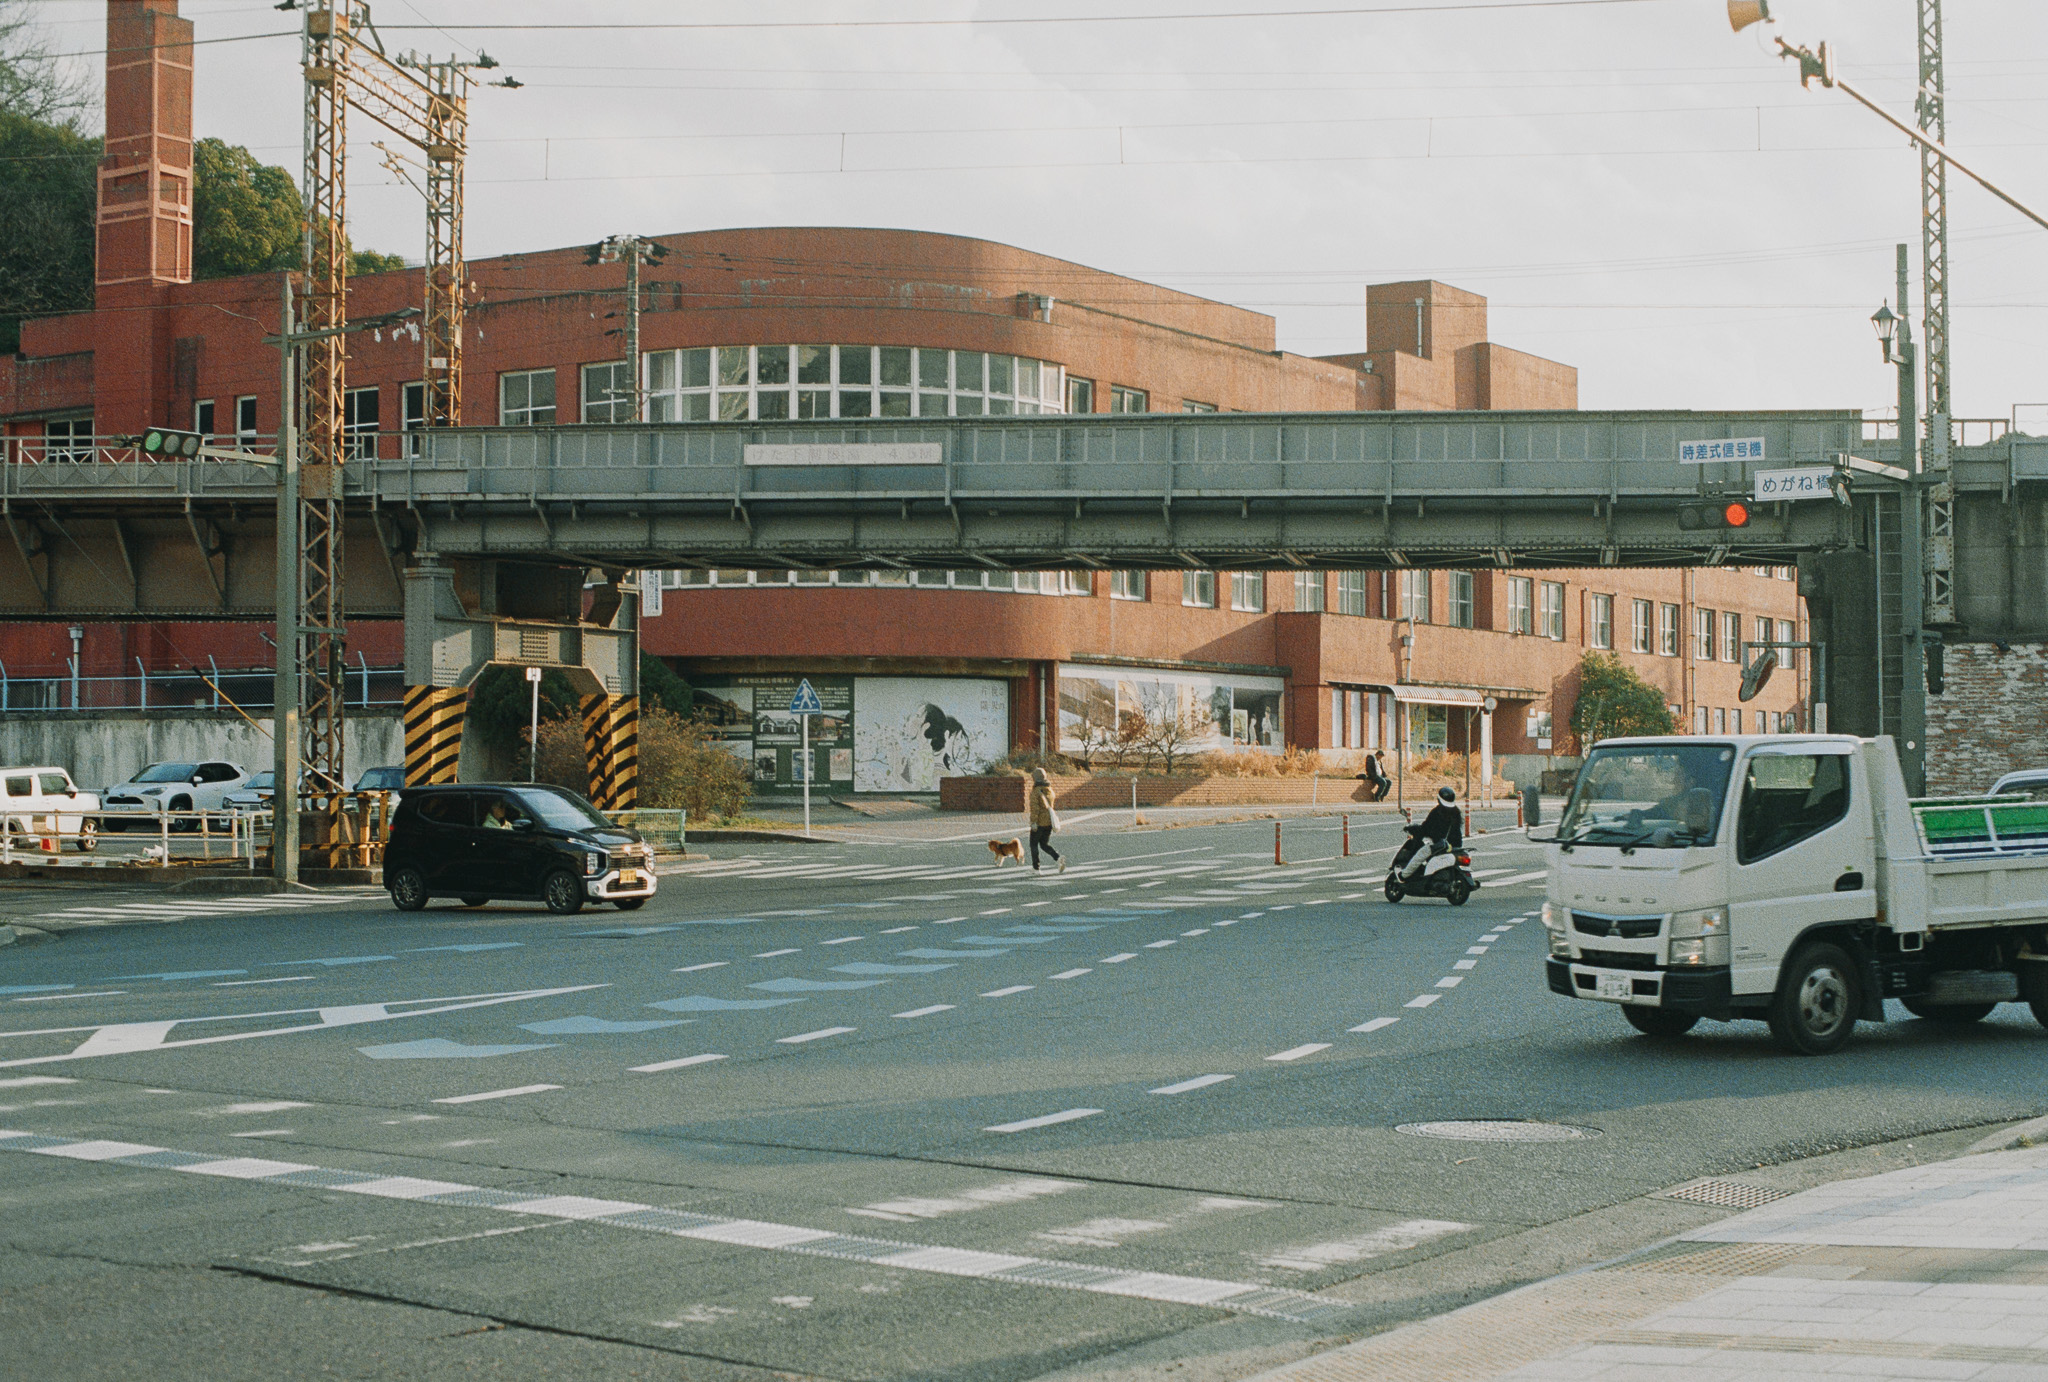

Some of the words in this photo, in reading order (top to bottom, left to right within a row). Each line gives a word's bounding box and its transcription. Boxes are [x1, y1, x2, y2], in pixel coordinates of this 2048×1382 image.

[1682, 441, 1762, 460] 時差式信号機
[1762, 475, 1831, 493] めがね橋
[1573, 893, 1657, 905] FUSO
